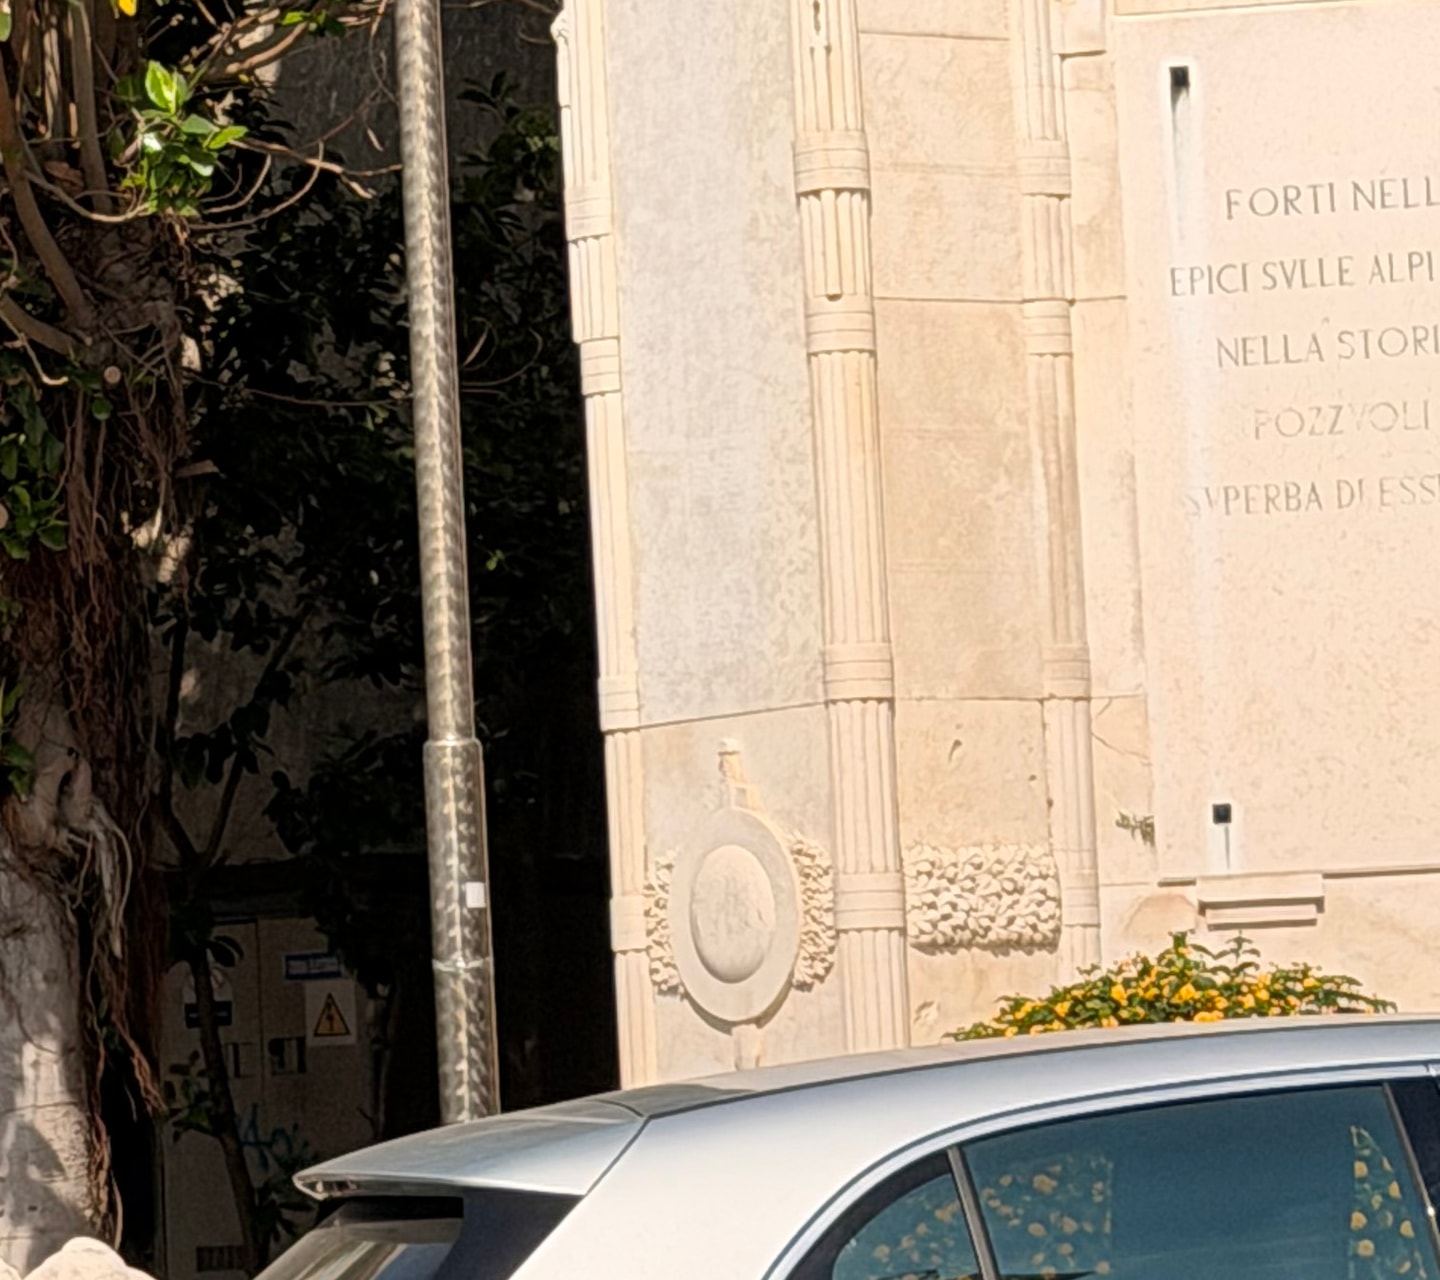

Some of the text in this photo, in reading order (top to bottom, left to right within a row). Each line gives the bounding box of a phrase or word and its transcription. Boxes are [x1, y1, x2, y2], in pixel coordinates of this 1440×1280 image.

[1225, 182, 1336, 220] FORTI
[1169, 263, 1248, 297] EPICI
[1261, 255, 1355, 291] SVLLE
[1216, 332, 1325, 369] NELLA
[1185, 473, 1440, 518] SVPERBA DI ESS
